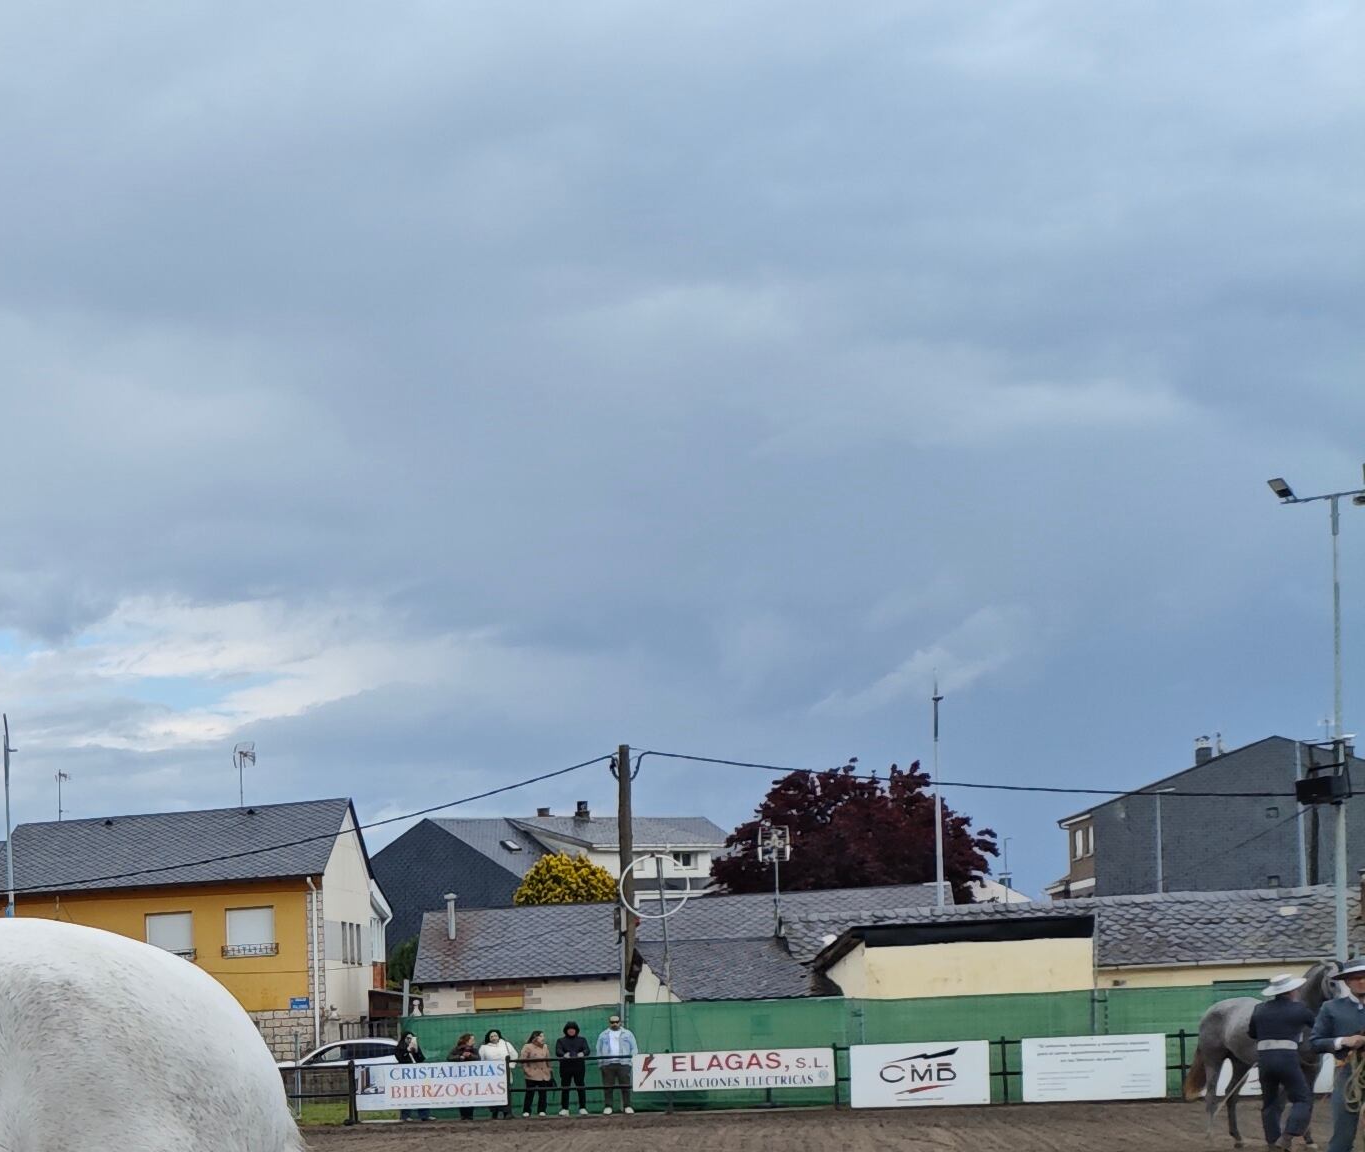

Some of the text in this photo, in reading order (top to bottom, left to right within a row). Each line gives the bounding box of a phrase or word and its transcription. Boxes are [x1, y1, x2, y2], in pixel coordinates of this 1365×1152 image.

[389, 1063, 505, 1080] CRISTALERIAS
[671, 1052, 829, 1073] ELAGAS, S.L.
[653, 1074, 814, 1089] INSTALACIONES ELECTRICAS
[879, 1062, 957, 1083] CMB
[390, 1081, 506, 1099] BIERZOGLAS
